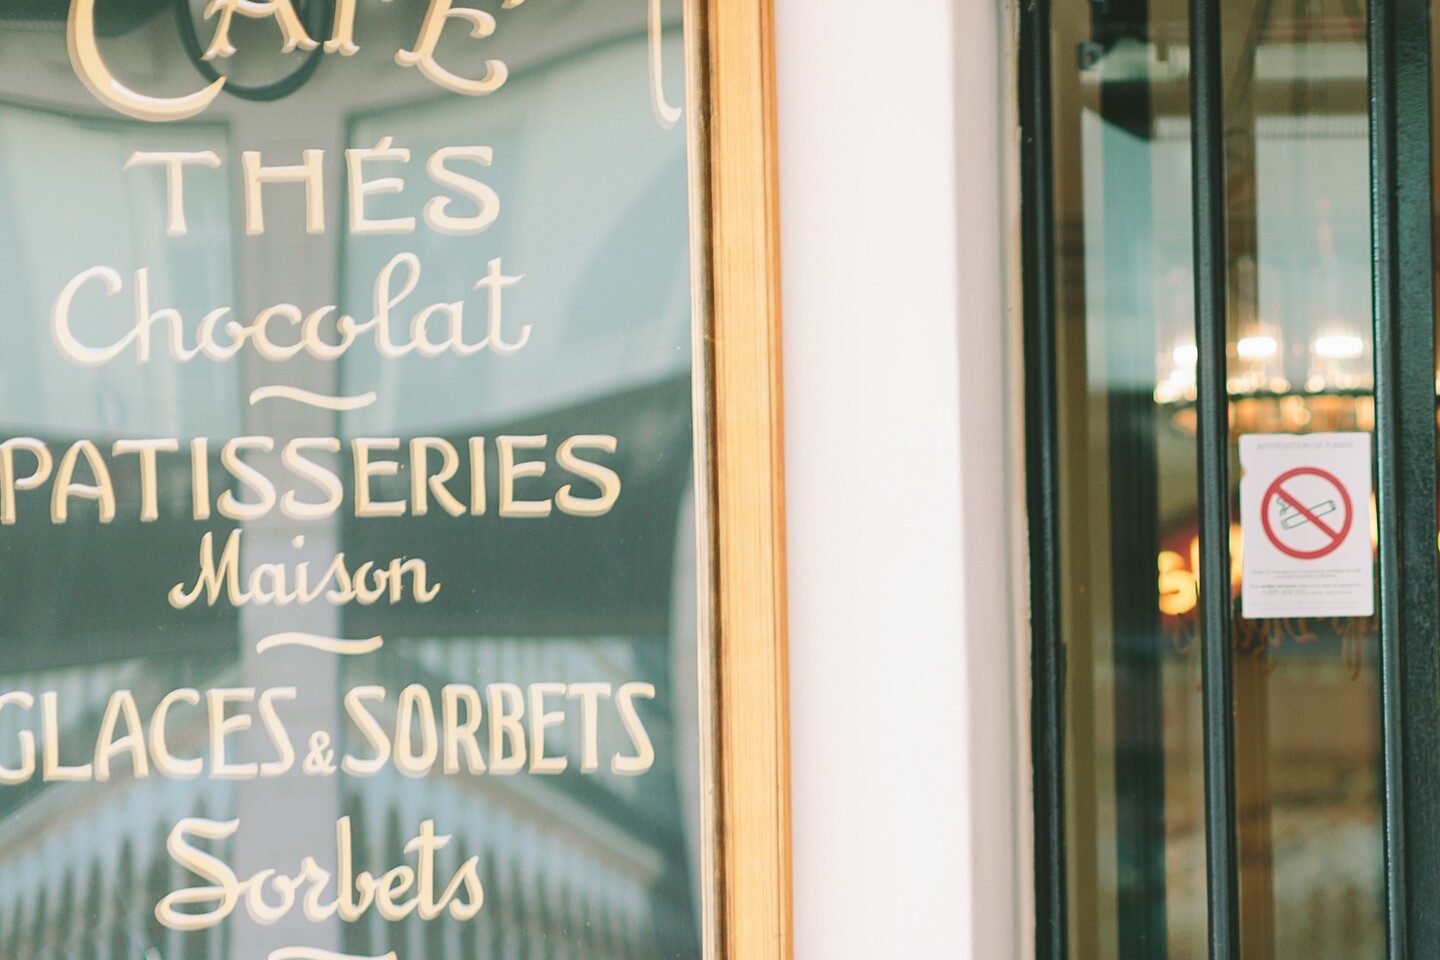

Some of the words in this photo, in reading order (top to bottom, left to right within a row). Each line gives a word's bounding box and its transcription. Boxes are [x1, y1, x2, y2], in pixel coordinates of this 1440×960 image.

[122, 136, 501, 237] THÉS
[50, 252, 534, 366] Chocolat
[0, 434, 622, 524] PATISSERIES
[168, 528, 441, 609] Maison
[0, 686, 297, 785] GLACES
[303, 728, 338, 776] &
[341, 681, 656, 776] SORBETS
[155, 815, 485, 930] Sorbets
